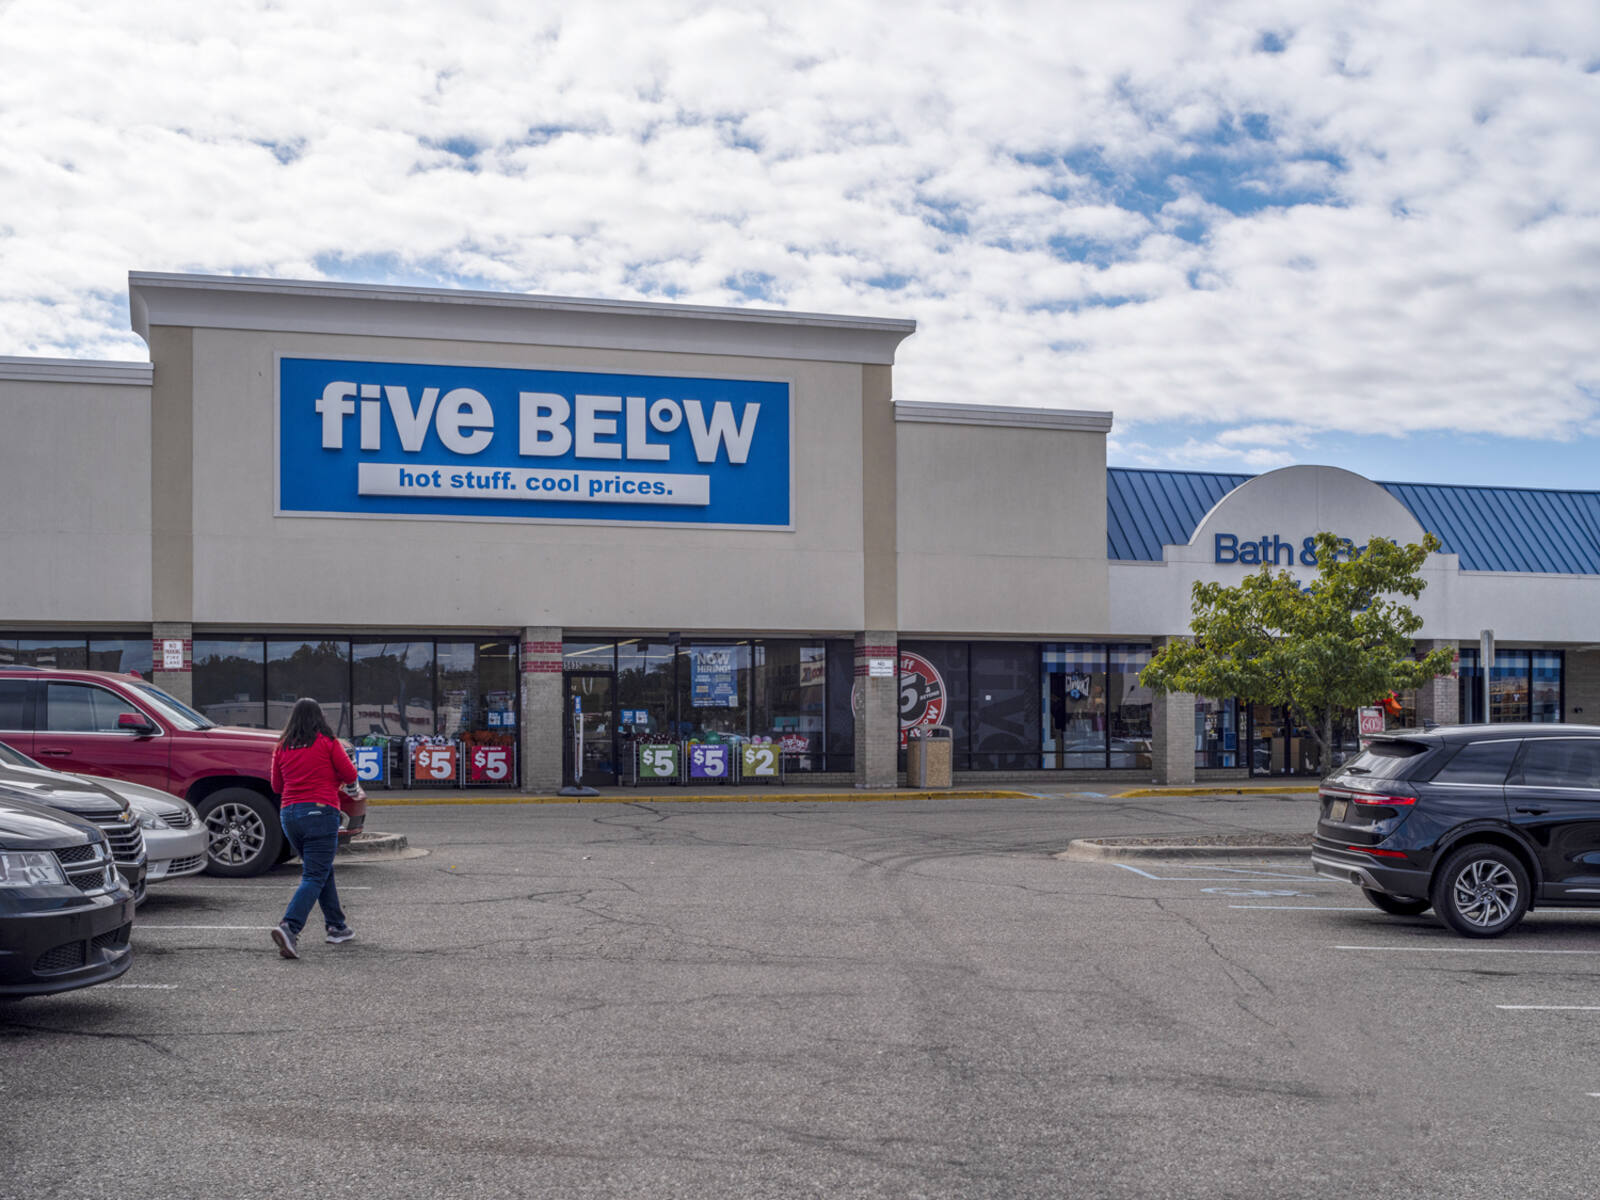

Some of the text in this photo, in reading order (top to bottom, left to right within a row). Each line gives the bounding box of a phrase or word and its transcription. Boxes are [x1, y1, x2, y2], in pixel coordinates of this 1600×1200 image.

[315, 381, 495, 455] five
[400, 468, 674, 498] hot stuff. cool prices.
[1215, 533, 1295, 566] Bath
[1300, 536, 1319, 567] &
[697, 653, 730, 665] NOW
[358, 751, 380, 780] 5
[418, 750, 452, 779] $5
[474, 750, 508, 779] $5
[642, 749, 675, 777] $5
[693, 749, 725, 777] $5
[744, 748, 775, 776] $2
